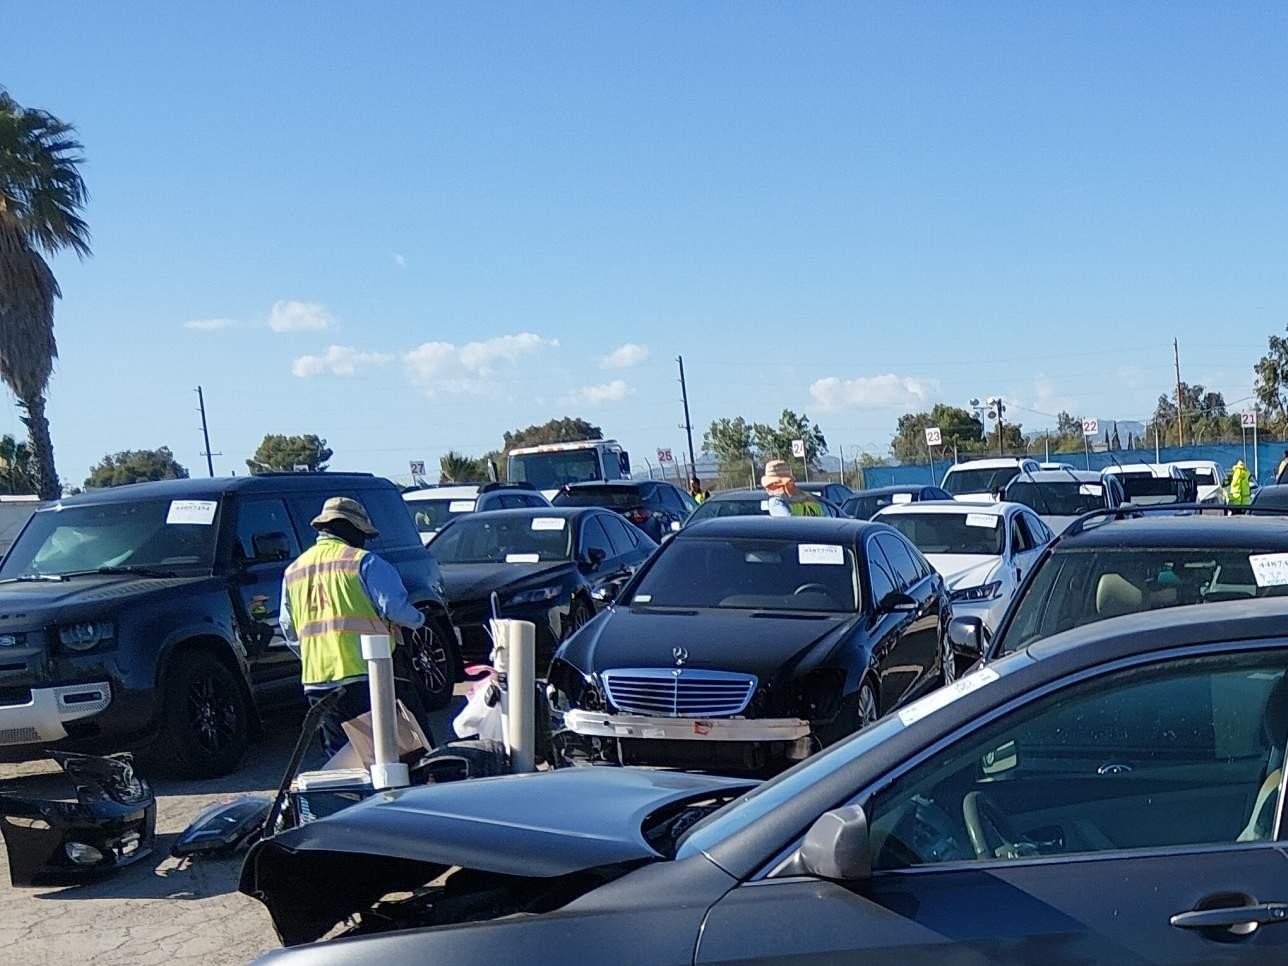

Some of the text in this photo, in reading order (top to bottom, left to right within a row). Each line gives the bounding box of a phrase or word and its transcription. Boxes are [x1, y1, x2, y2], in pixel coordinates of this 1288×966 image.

[1243, 414, 1255, 425] 21
[1084, 420, 1097, 432] 22
[928, 431, 940, 442] 23
[411, 463, 424, 474] 27
